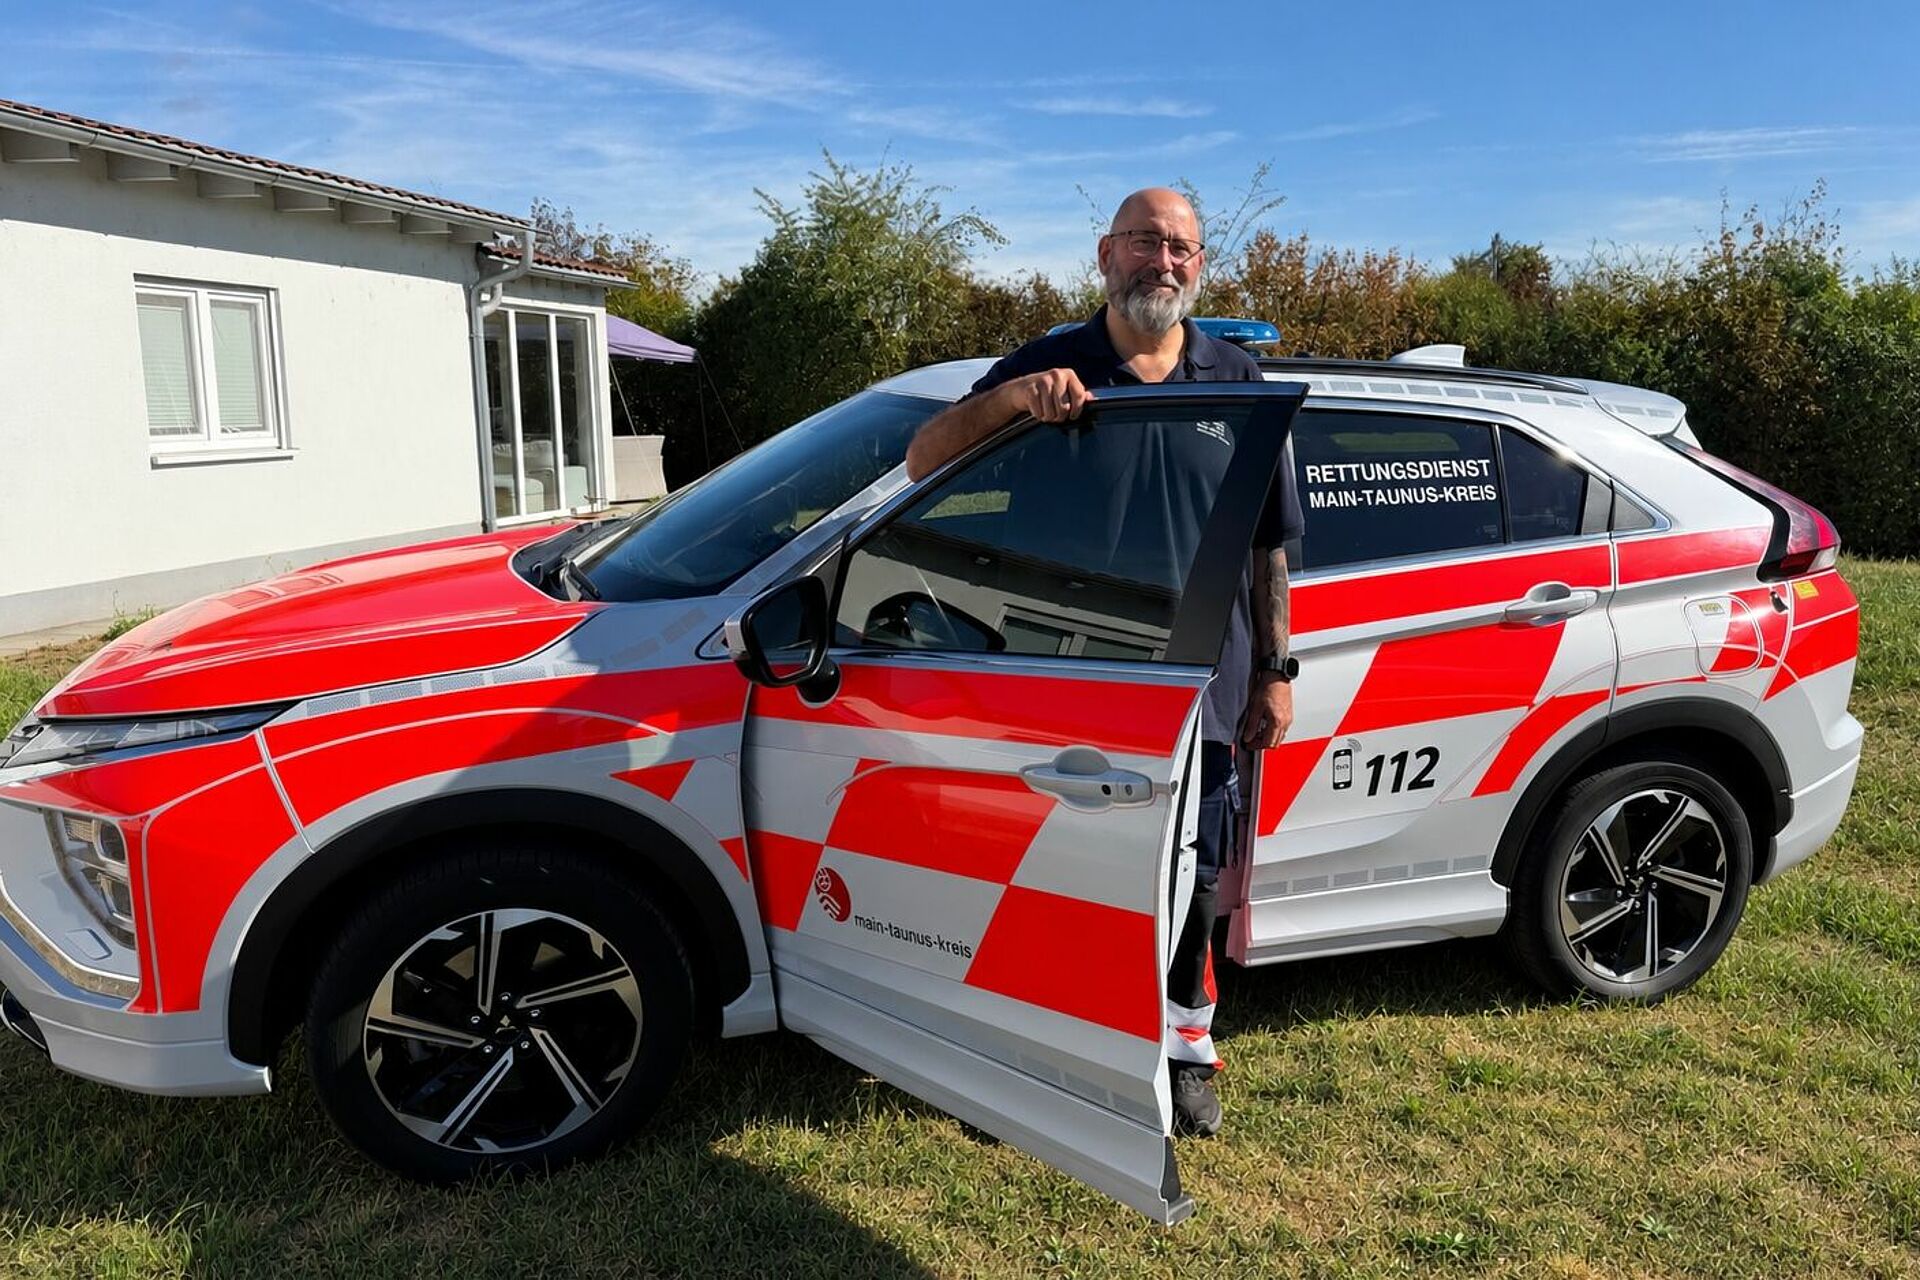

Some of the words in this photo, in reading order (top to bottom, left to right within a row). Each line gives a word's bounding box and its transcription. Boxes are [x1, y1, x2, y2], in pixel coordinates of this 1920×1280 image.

[1306, 460, 1490, 483] RETTUNGSDIENST
[1309, 485, 1497, 508] MAIN-TAUNUS-KREIS
[1366, 746, 1440, 797] 112
[854, 914, 972, 959] main-taunus-kreis
